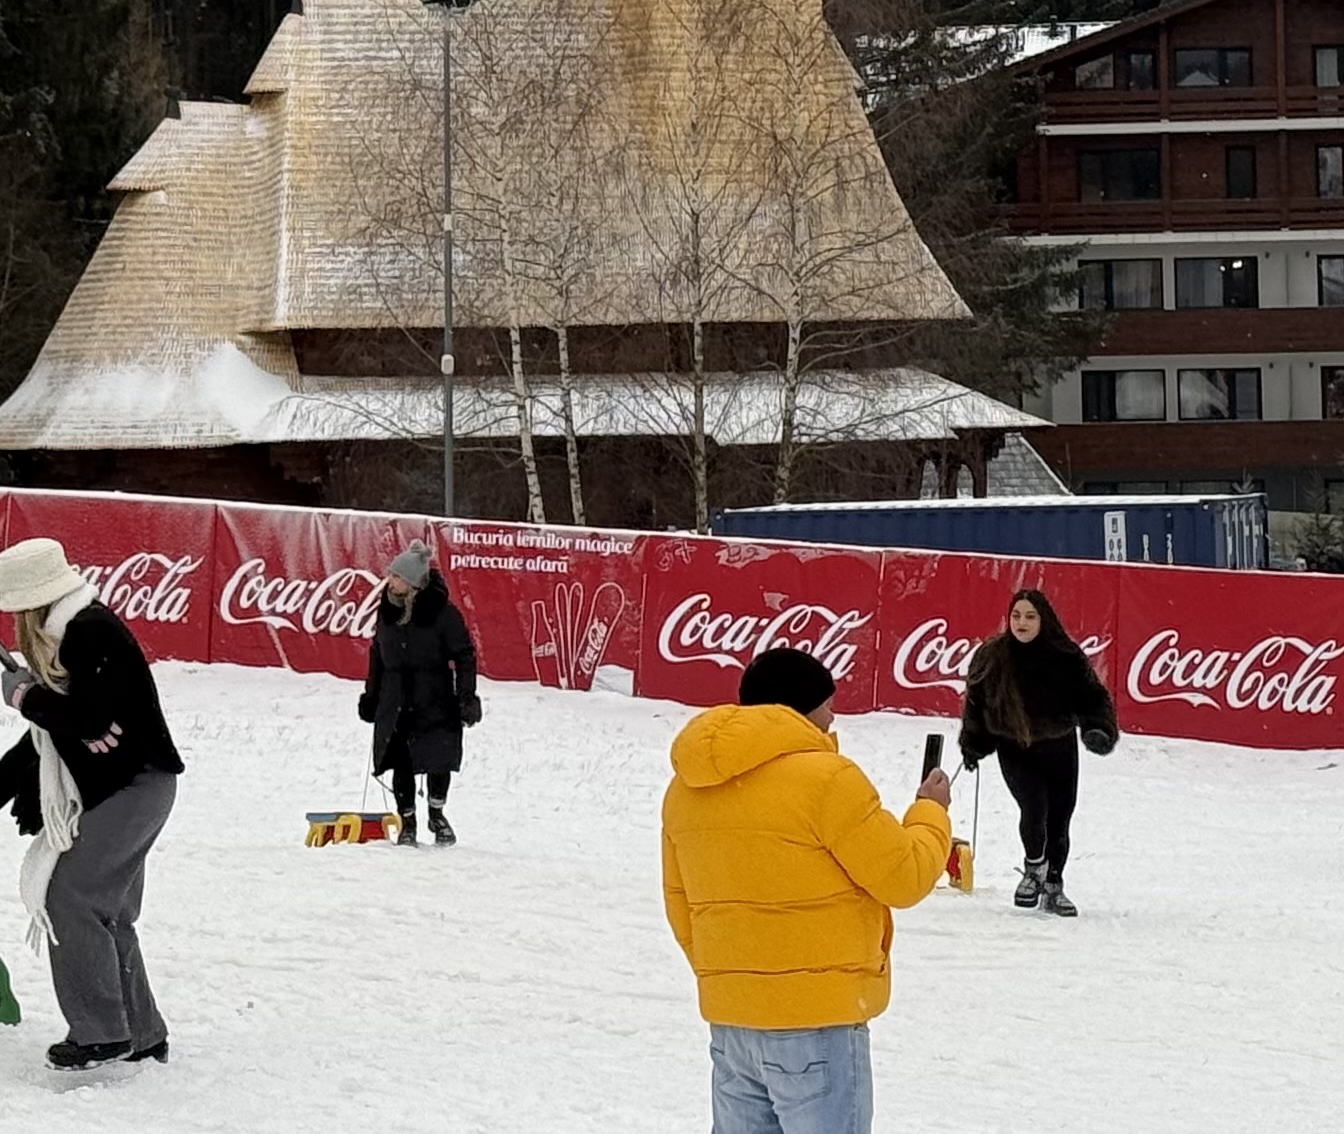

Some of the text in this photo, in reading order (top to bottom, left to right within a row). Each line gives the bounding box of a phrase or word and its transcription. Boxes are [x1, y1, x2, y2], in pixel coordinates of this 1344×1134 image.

[452, 527, 513, 546] Bucuria
[574, 536, 633, 557] magice
[450, 553, 569, 573] petrecute afară
